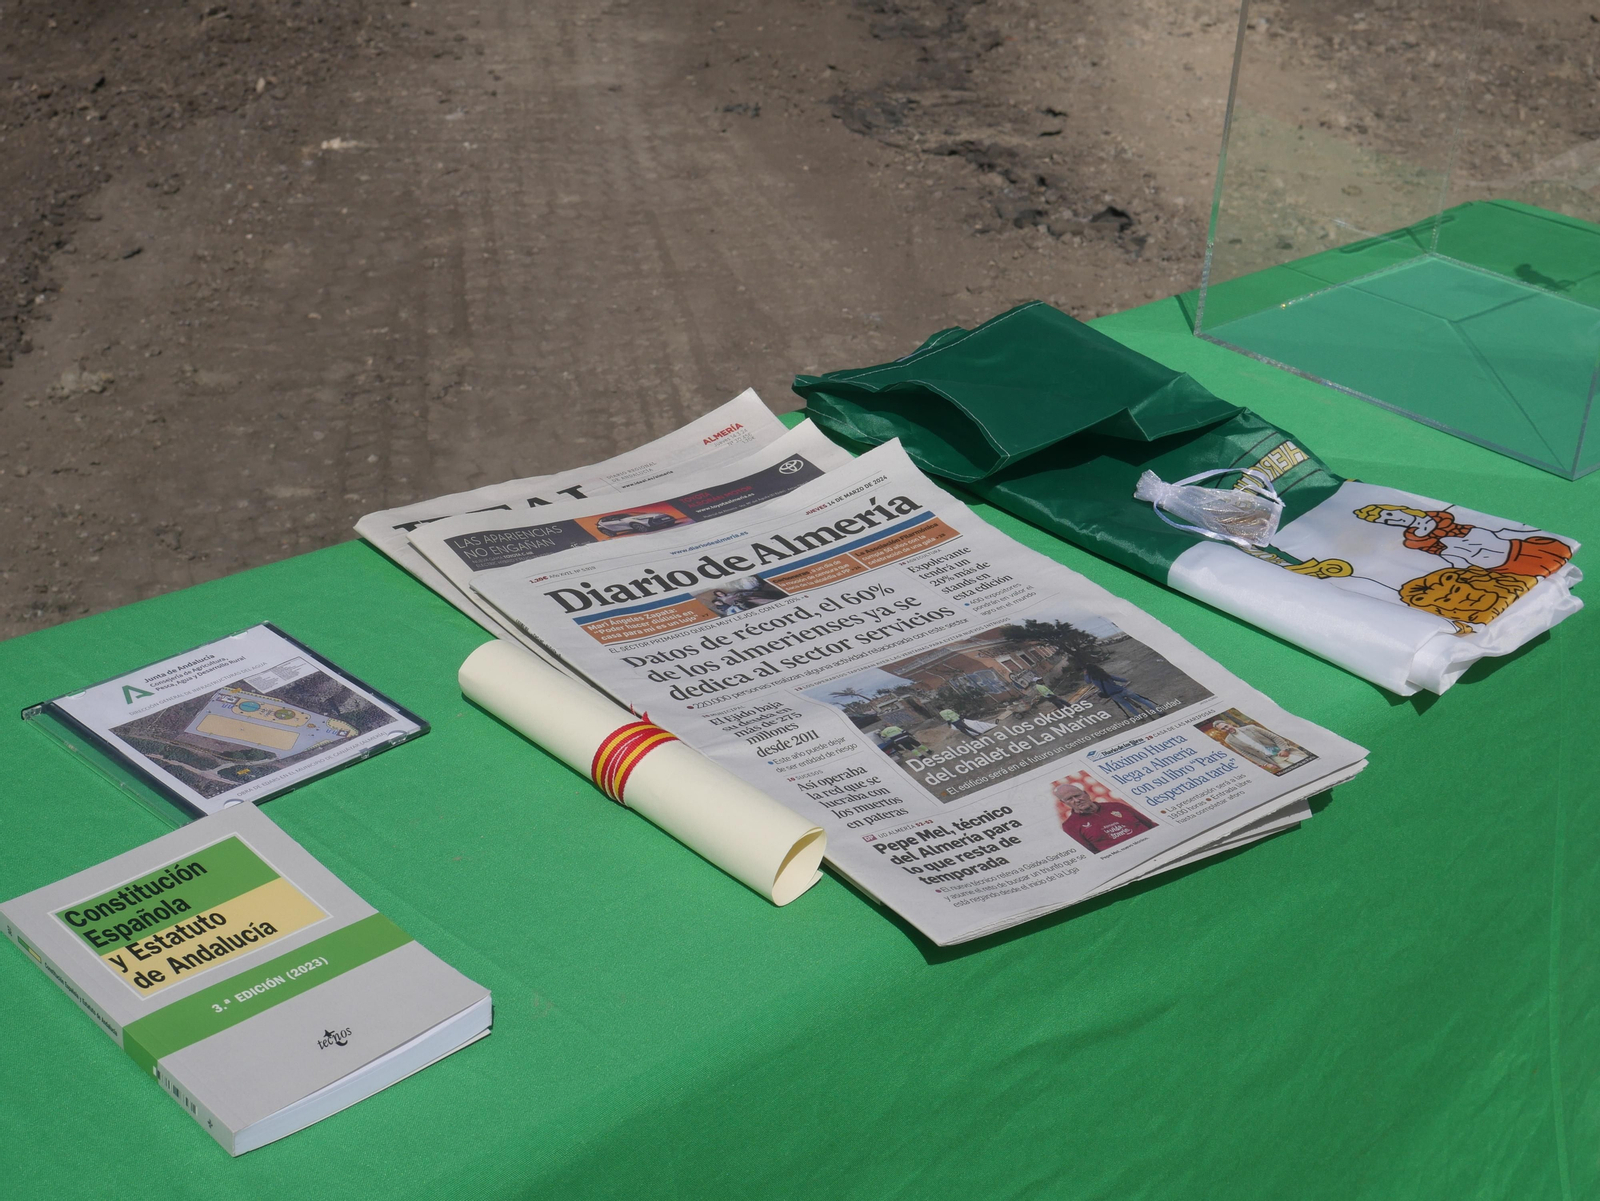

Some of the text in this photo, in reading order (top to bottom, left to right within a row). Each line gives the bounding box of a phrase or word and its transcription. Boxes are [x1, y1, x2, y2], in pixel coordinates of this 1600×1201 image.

[703, 423, 743, 446] ALMERÍA
[805, 475, 888, 515] JUEVES MARZO 2024
[454, 525, 563, 550] LAS APARIENCIAS
[751, 495, 923, 565] Almería
[463, 547, 488, 559] NO
[490, 537, 556, 556] ENGAÑAN
[907, 546, 972, 574] Expolevante
[919, 557, 971, 580] tendrá un
[930, 560, 991, 587] 20% más de
[941, 572, 991, 595] stands en
[952, 574, 1013, 602] esta edición
[586, 608, 677, 632] Mari Ángeles Zapata:
[620, 583, 895, 668] Datos de récord, el 60%
[625, 614, 682, 630] hacer diálisis
[601, 629, 643, 641] casa para
[619, 618, 733, 652] SECTOR PRIMARIO QUEDA MUY
[648, 596, 922, 683] de los almerienses ya se
[144, 653, 216, 683] Junta Andalucía
[669, 606, 955, 702] dedica al sector servicios
[693, 618, 969, 710] 220.000 personas realizan alguna actividad relacionada sector
[150, 656, 229, 688] Consejería Agricultura,
[155, 655, 247, 692] Pesca, Agua Desarrollo Rural
[159, 692, 186, 705] GENERAL
[709, 700, 784, 726] El Ejido baja
[734, 712, 802, 738] más de 275
[739, 707, 793, 729] deuda en
[1185, 708, 1216, 726] MARIPOSAS
[745, 722, 799, 745] millones
[756, 729, 819, 758] desde 2011
[905, 699, 1094, 772] Desalojan a los okupas
[925, 710, 1112, 786] del chalet de La Marina
[946, 785, 959, 796] El
[958, 775, 989, 791] edificio
[989, 767, 1009, 780] será
[1008, 763, 1021, 772] en
[1027, 750, 1053, 764] futuro
[1065, 735, 1091, 750] centro
[1091, 719, 1130, 739] recreativo
[1130, 712, 1150, 724] para
[1156, 699, 1182, 713] ciudad
[772, 735, 847, 765] Este puede dejar
[798, 743, 858, 767] entidad riesgo
[1098, 734, 1188, 774] Máximo Huerta
[797, 765, 868, 792] Así operaba
[1111, 746, 1198, 785] llega a Almería
[1130, 749, 1228, 796] con su libro “París
[806, 775, 881, 801] la red que se
[1145, 758, 1239, 806] despertaba tarde”
[1174, 784, 1217, 809] presentación
[818, 786, 891, 809] lucraba con
[831, 795, 904, 819] los muertos
[846, 807, 909, 829] en pateras
[873, 806, 1013, 854] Pepe Mel, técnico
[889, 824, 915, 836] ALMERÍA
[890, 819, 1022, 865] del Almería para
[902, 836, 1022, 875] lo que resta de
[918, 856, 1010, 885] temporada
[972, 846, 1077, 888] técnico releva Garitano
[64, 861, 208, 927] Constitución
[82, 896, 192, 948] Española
[108, 911, 227, 974] y Estatuto
[133, 921, 278, 989] de Andalucía
[211, 956, 329, 1013] 3.ª EDICIÓN (2023)
[317, 1027, 352, 1050] tecnos
